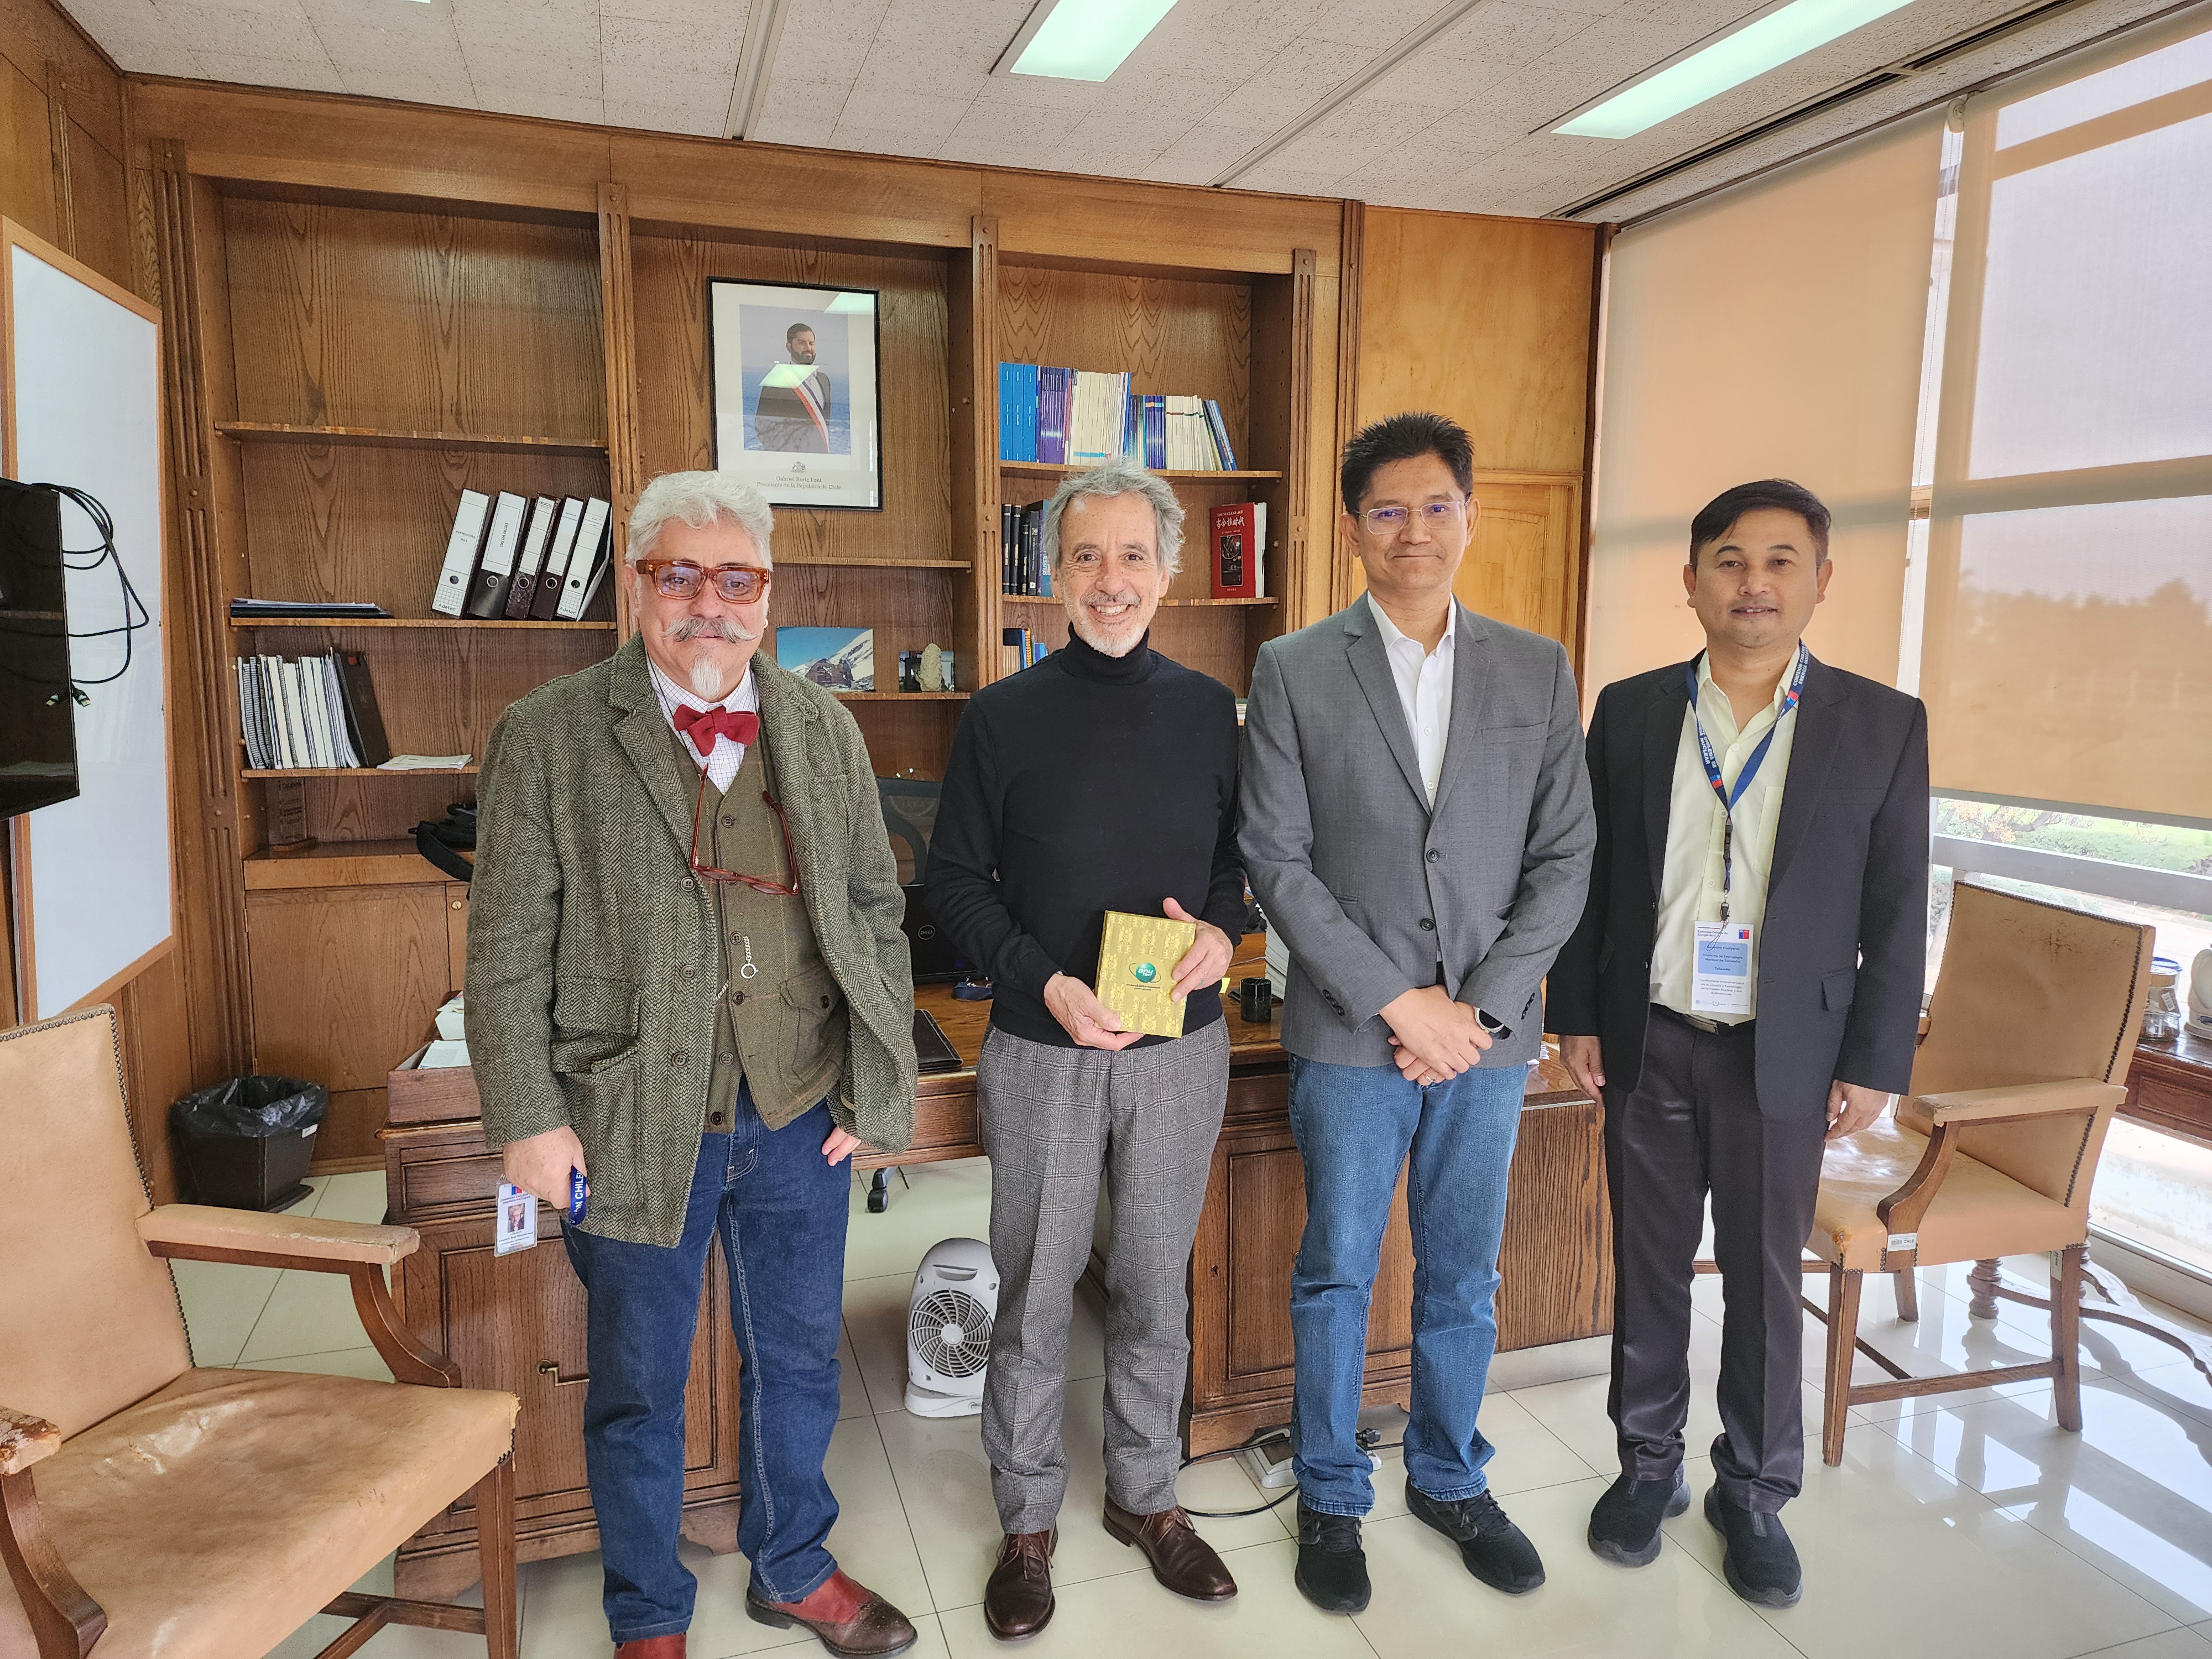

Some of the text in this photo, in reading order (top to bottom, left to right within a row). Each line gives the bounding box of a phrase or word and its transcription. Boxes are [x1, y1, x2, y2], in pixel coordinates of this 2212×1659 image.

[499, 521, 509, 547] ENTREVISTAS
[437, 603, 456, 612] Adetec
[559, 606, 576, 615] Adetec
[1792, 663, 1803, 686] COMISION
[1798, 665, 1807, 685] ENERGIA
[1700, 737, 1710, 764] NUCLEAR
[1704, 736, 1717, 769] CHILENA DE
[575, 1171, 584, 1199] CHILE
